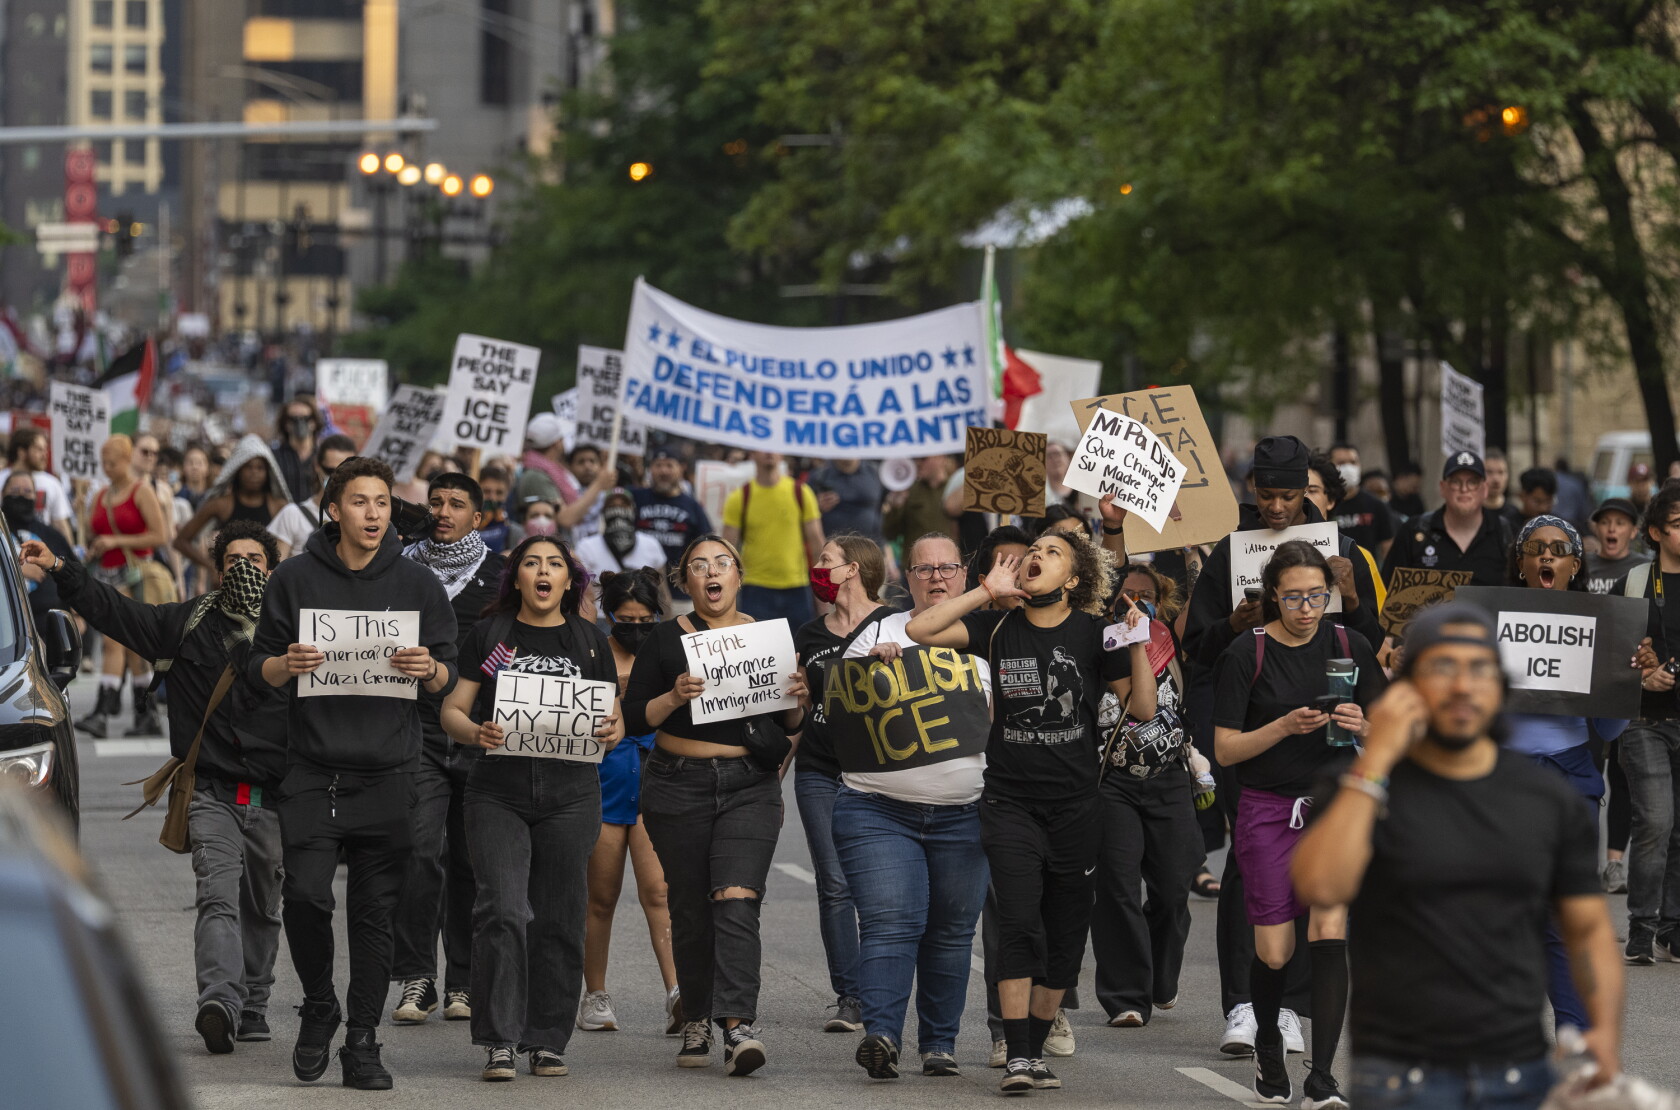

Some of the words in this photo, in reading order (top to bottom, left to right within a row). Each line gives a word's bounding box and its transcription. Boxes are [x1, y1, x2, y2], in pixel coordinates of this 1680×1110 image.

[480, 342, 517, 362] THE
[691, 338, 720, 364] EL
[726, 349, 838, 380] PUEBLO
[849, 351, 933, 380] UNIDO
[457, 355, 532, 385] PEOPLE
[66, 390, 91, 403] THE
[473, 376, 511, 395] SAY
[653, 354, 866, 417] DEFENDERÁ
[877, 387, 903, 415] A
[911, 375, 972, 411] LAS
[54, 402, 106, 422] PEOPLE
[464, 397, 509, 424] ICE
[625, 378, 773, 440] FAMILIAS
[66, 418, 92, 433] SAY
[456, 420, 510, 446] OUT
[1092, 412, 1123, 436] Mi
[1124, 421, 1148, 452] Pa
[64, 437, 94, 456] ICE
[965, 427, 1047, 468] ABOLISH
[62, 457, 97, 476] OUT
[1078, 455, 1097, 472] Su
[1103, 464, 1142, 490] Madre
[1123, 452, 1166, 493] Chingue
[962, 492, 1046, 515] ICE
[312, 612, 336, 642] IS
[345, 614, 400, 640] This
[1498, 622, 1595, 648] ABOLISH
[311, 645, 381, 665] merica?
[687, 633, 747, 664] Fight
[702, 655, 777, 687] Ignorance
[1001, 659, 1036, 669] ABOLISH
[1526, 657, 1562, 679] ICE
[311, 670, 358, 689] Nazi
[748, 672, 778, 688] NOT
[824, 646, 983, 716] ABOLISH
[1000, 673, 1039, 684] POLICE
[499, 673, 530, 705] I
[539, 677, 607, 713] LIKE
[700, 688, 782, 714] Immigrants
[495, 707, 542, 733] MY
[864, 694, 960, 765] ICE
[504, 731, 600, 757] CRUSHED
[1004, 728, 1035, 743] CHEAP
[1138, 723, 1168, 745] Honk!
